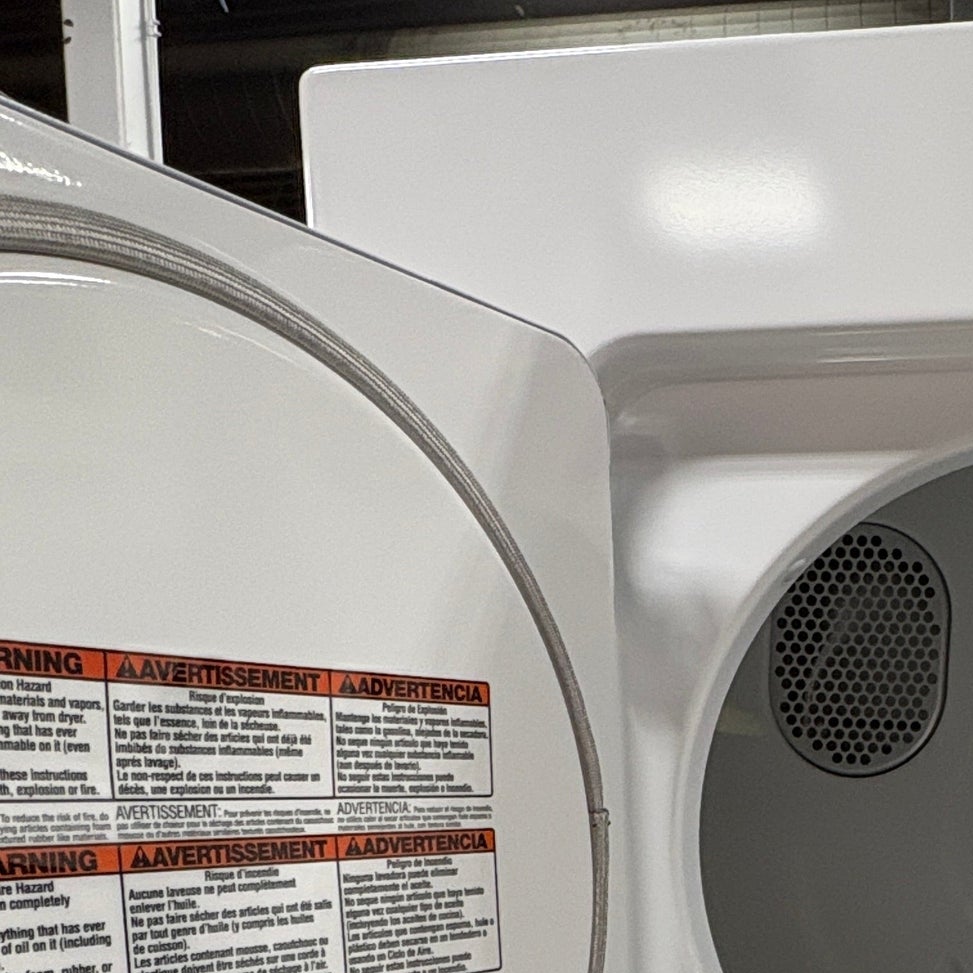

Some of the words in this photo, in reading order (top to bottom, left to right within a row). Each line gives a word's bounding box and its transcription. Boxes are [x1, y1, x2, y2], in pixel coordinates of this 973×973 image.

[140, 658, 320, 692] AVERTISSEMENT
[16, 679, 52, 693] Hazard
[358, 676, 483, 703] ADVERTENCIA
[48, 697, 66, 708] and
[68, 699, 105, 713] vapors,
[2, 710, 29, 724] away
[32, 709, 56, 722] from
[58, 711, 87, 725] dryer.
[13, 724, 33, 736] that
[35, 724, 53, 737] has
[56, 727, 78, 738] ever
[39, 741, 51, 752] on
[54, 739, 61, 752] it
[64, 740, 90, 755] (even
[30, 768, 88, 781] instructions
[16, 784, 66, 798] explosion
[68, 786, 78, 796] or
[80, 784, 100, 796] fire.
[337, 801, 412, 816] ADVERTENCIA:
[363, 832, 488, 855] ADVERTENCIA
[153, 839, 327, 868] AVERTISSEMENT
[204, 870, 235, 883] Risque
[15, 880, 55, 895] Hazard
[129, 888, 164, 901] Aucune
[166, 886, 202, 899] laveuse
[203, 884, 215, 895] ne
[217, 882, 236, 896] peut
[9, 894, 70, 911] completely
[129, 901, 165, 914] enlever
[130, 915, 145, 928] Ne
[146, 914, 164, 929] pas
[165, 912, 188, 925] faire
[221, 907, 238, 919] des
[37, 923, 59, 937] that
[61, 922, 80, 935] has
[83, 921, 106, 933] ever
[132, 930, 148, 944] par
[149, 928, 169, 940] tout
[170, 926, 197, 940] genre
[1, 942, 12, 955] of
[15, 940, 30, 954] oil
[32, 941, 47, 953] on
[49, 938, 57, 951] it
[59, 934, 112, 952] (including
[133, 943, 146, 955] de
[134, 956, 152, 969] Les
[153, 952, 189, 967] articles
[190, 946, 235, 962] contenant
[101, 962, 113, 973] or
